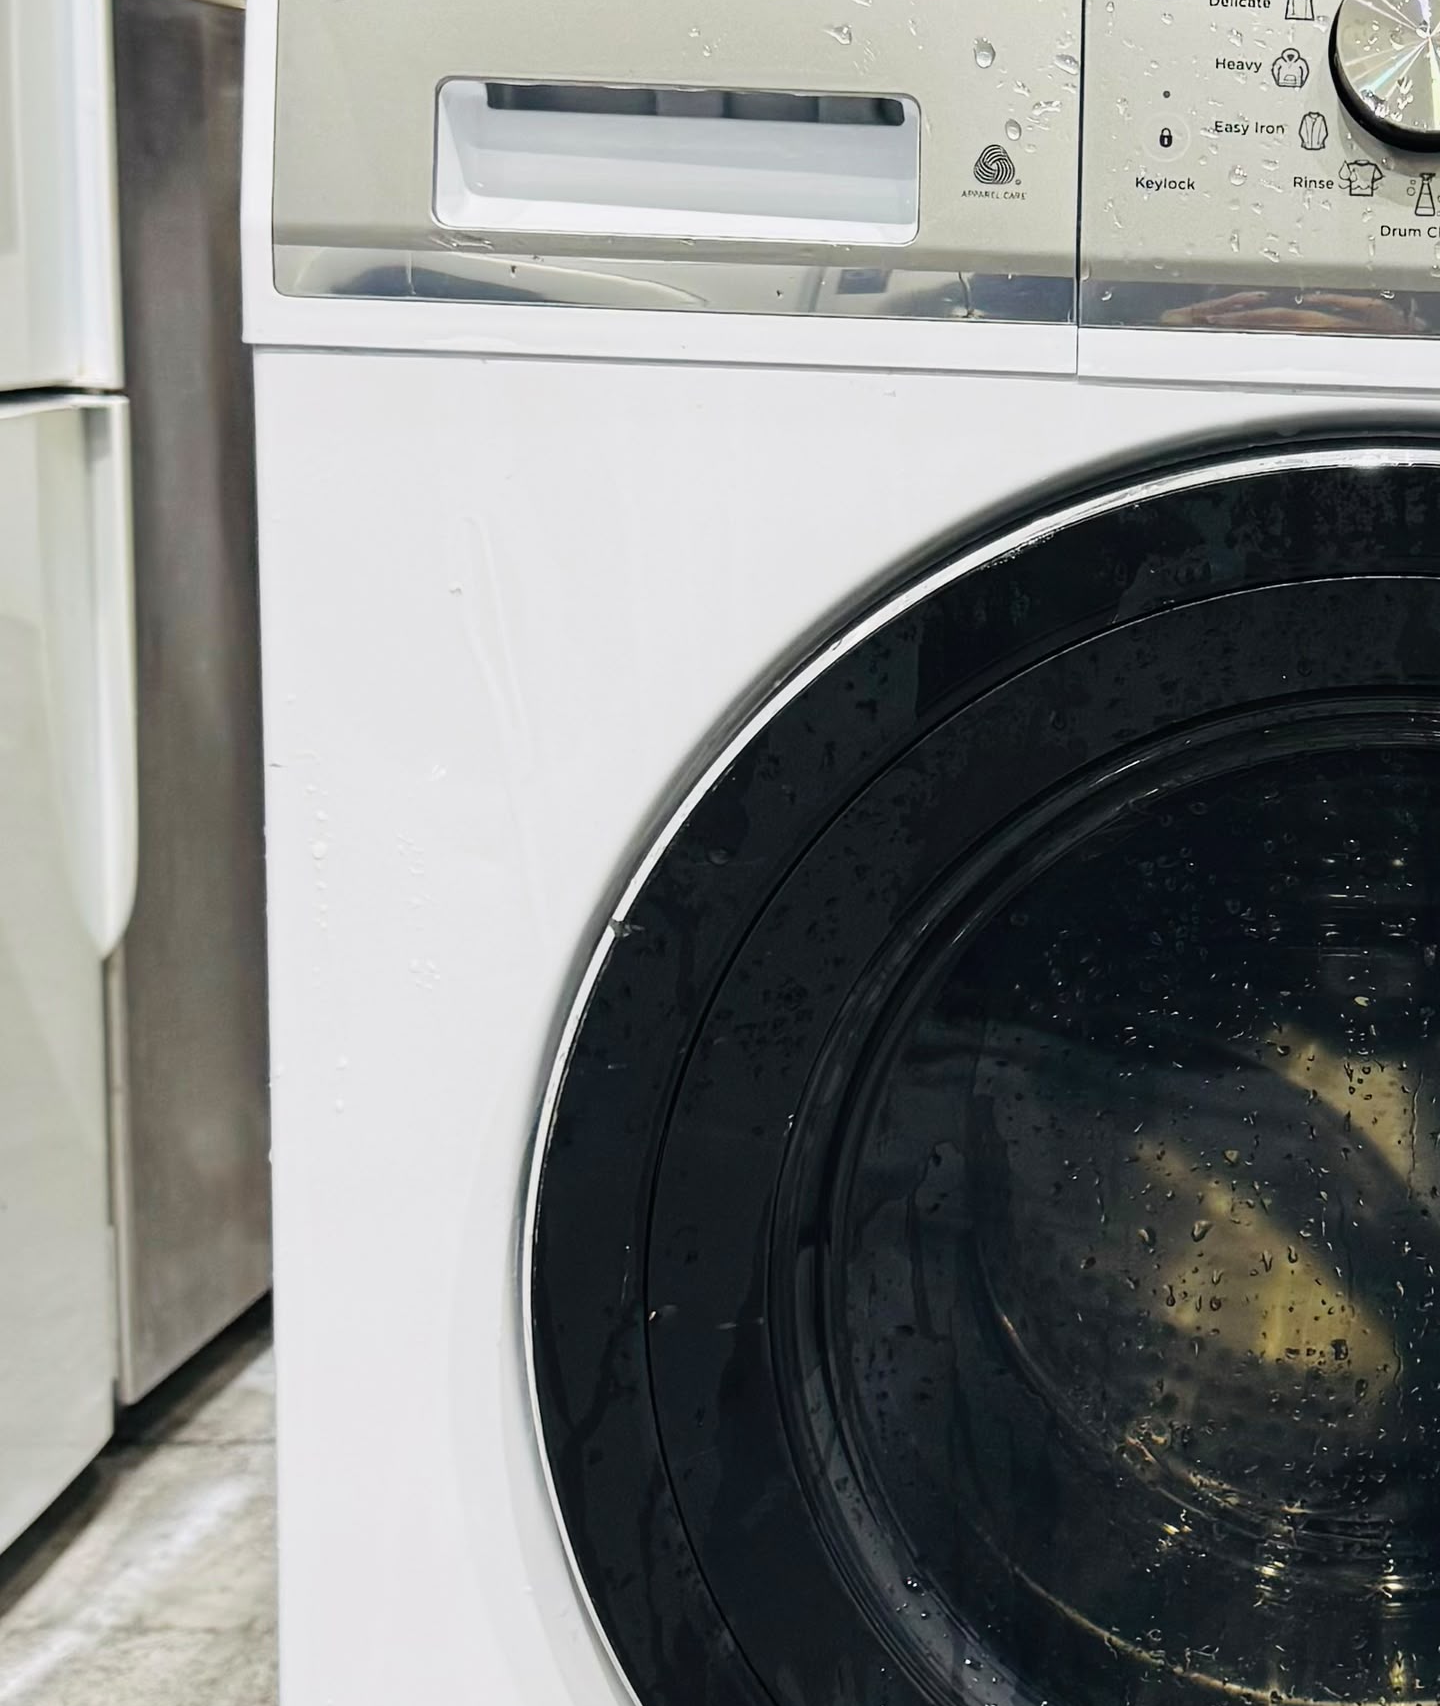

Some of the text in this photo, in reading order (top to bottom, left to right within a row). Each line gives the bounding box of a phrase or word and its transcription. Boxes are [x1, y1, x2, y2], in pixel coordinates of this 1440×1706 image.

[1215, 58, 1263, 74] Heavy
[1214, 121, 1285, 137] Easy Iron
[1135, 176, 1195, 193] Keylock
[1293, 176, 1334, 190] Rinse
[1380, 225, 1422, 239] Drum
